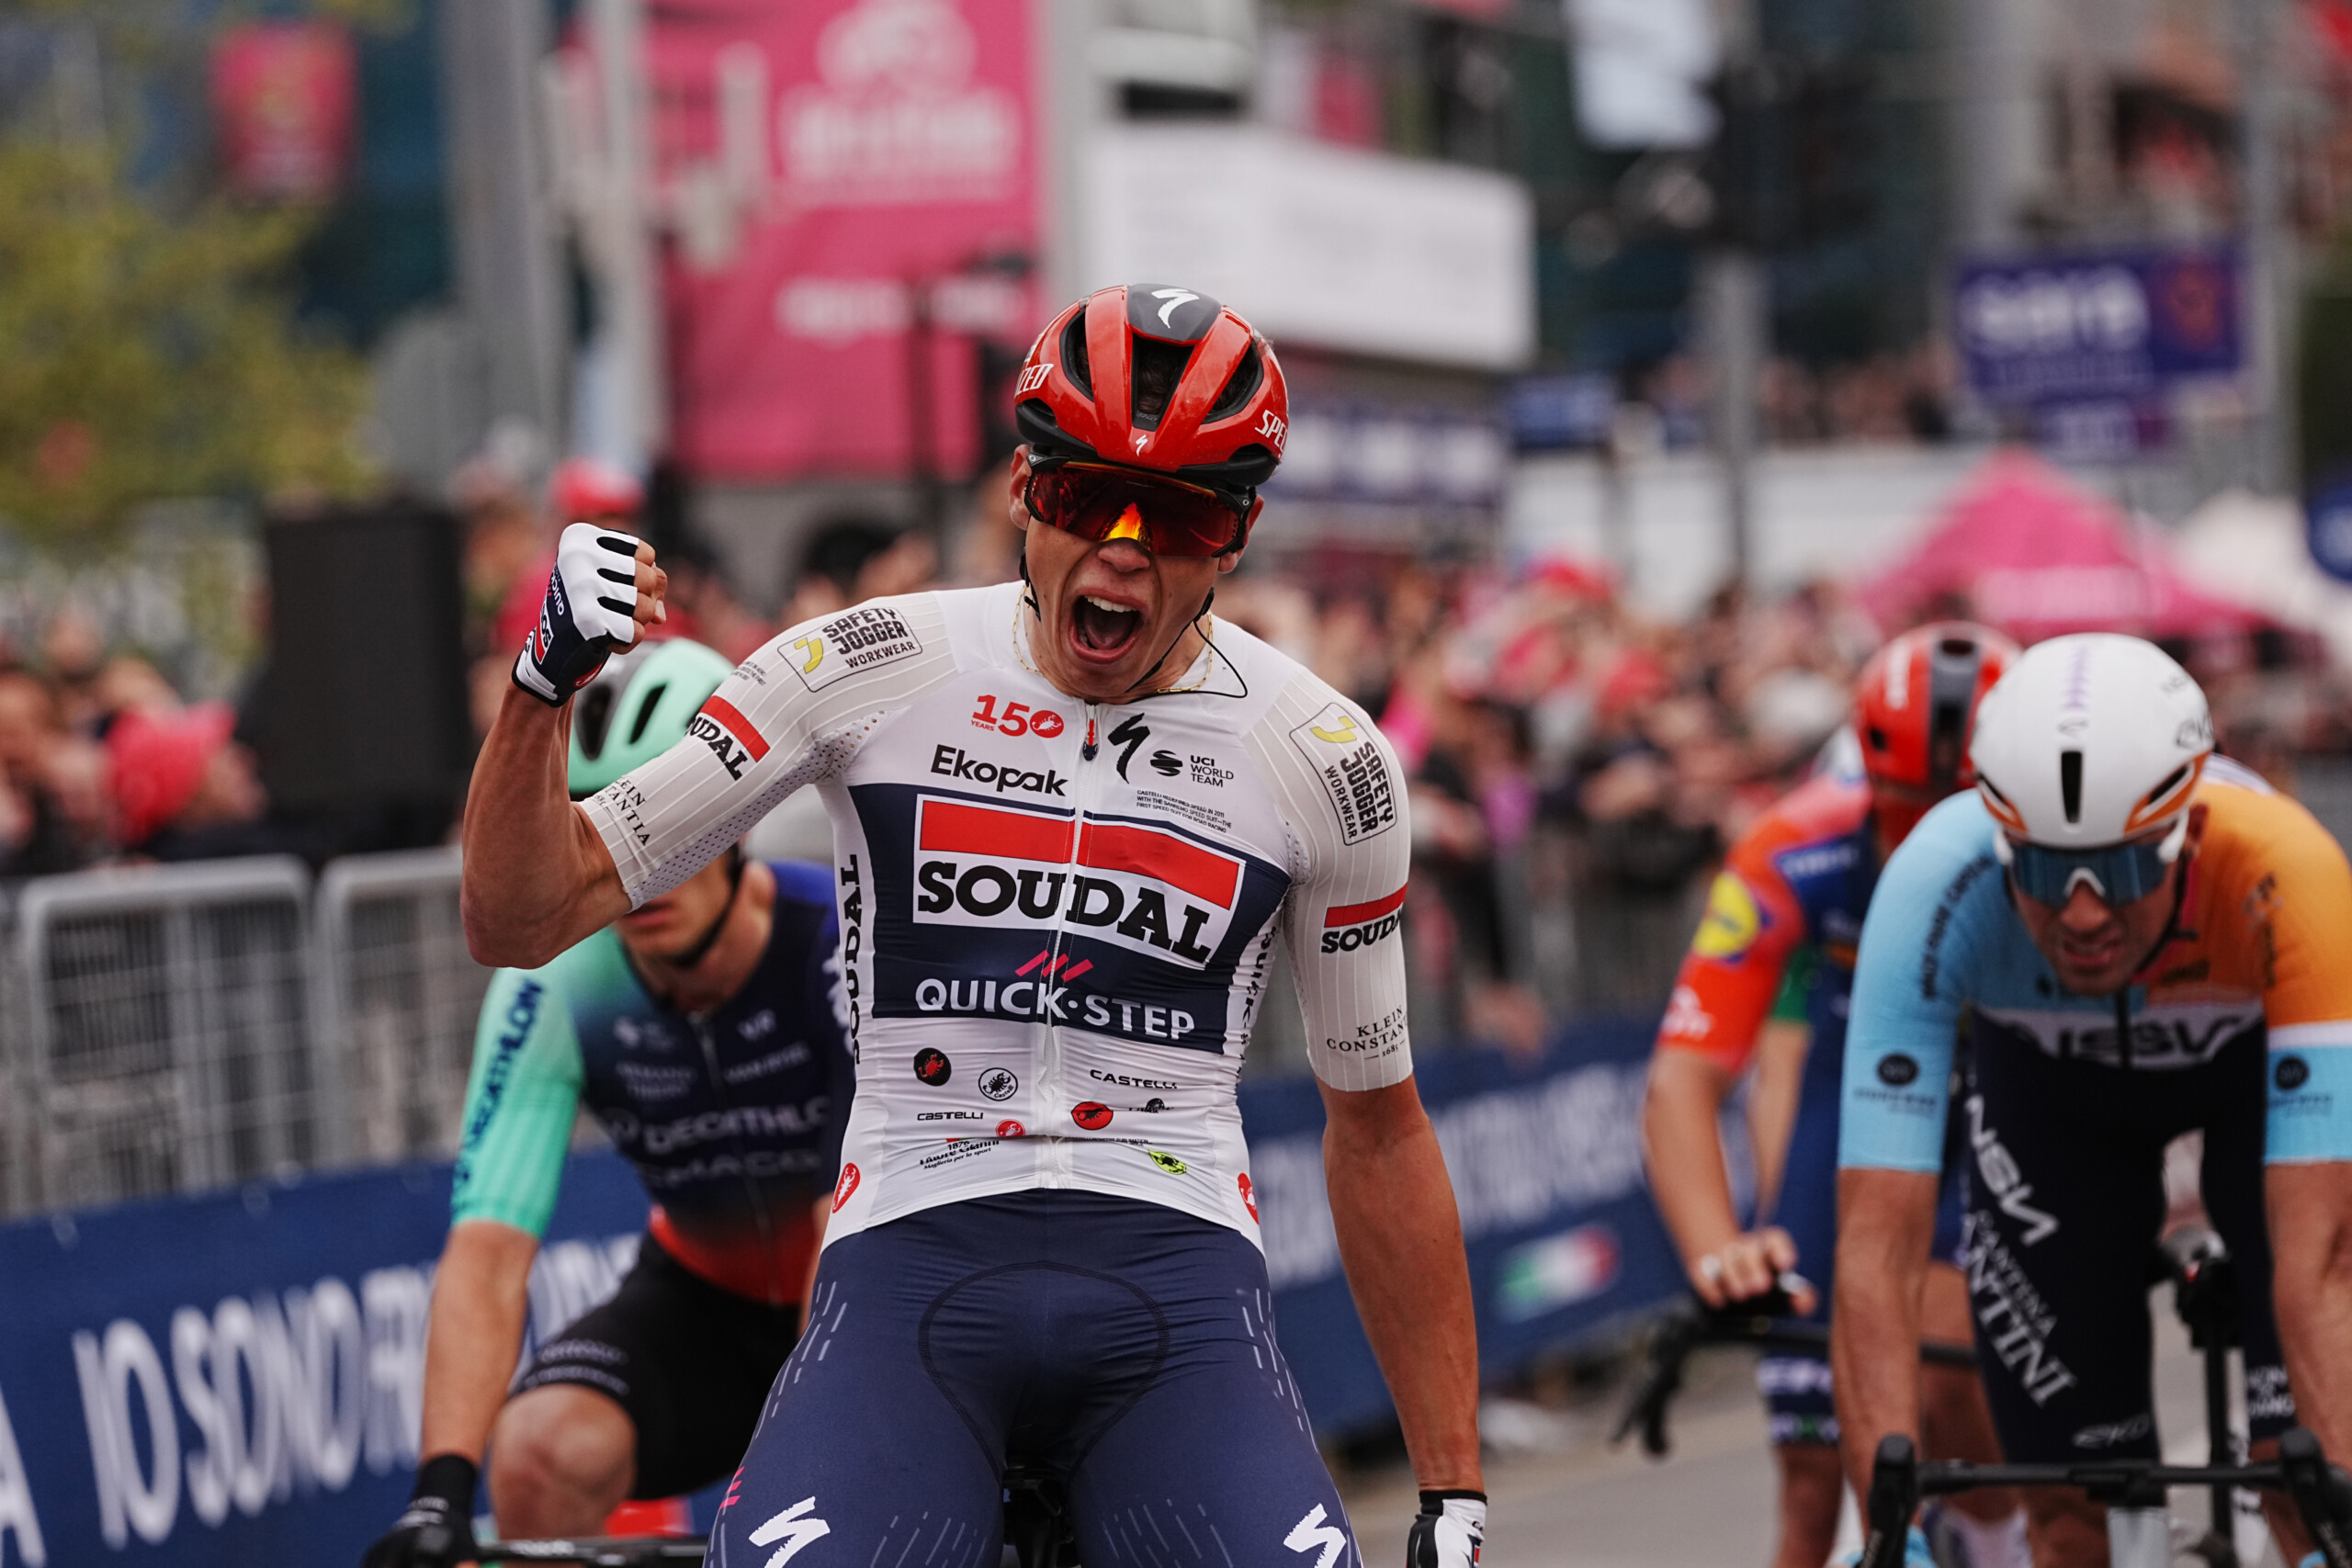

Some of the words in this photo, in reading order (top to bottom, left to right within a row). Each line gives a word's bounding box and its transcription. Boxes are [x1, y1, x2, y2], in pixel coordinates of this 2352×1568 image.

[822, 608, 897, 638] SAFETY
[831, 620, 909, 655] JOGGER
[845, 641, 916, 669] WORKWEAR
[971, 719, 995, 732] YEARS
[930, 744, 1069, 797] Ekopak
[1190, 755, 1215, 767] UCI
[1191, 764, 1234, 780] WORLD
[1191, 773, 1224, 788] TEAM
[1340, 750, 1379, 834] JOGGER
[1359, 741, 1394, 823] SAFETY
[1136, 790, 1162, 798] CASTELLI
[1214, 809, 1225, 818] 2011
[1189, 808, 1205, 818] SPEED
[1324, 765, 1358, 839] WORKWEAR
[1152, 804, 1170, 812] SPEED
[1207, 822, 1227, 833] RACING
[917, 860, 1212, 964] SOUDAL
[1356, 1005, 1404, 1038] KLEIN
[994, 1085, 1014, 1099] Castelli
[1090, 1069, 1178, 1089] CASTELLI
[923, 1158, 953, 1170] Maglieria
[954, 1154, 965, 1163] per
[974, 1147, 991, 1156] sport
[71, 1318, 182, 1551] IO
